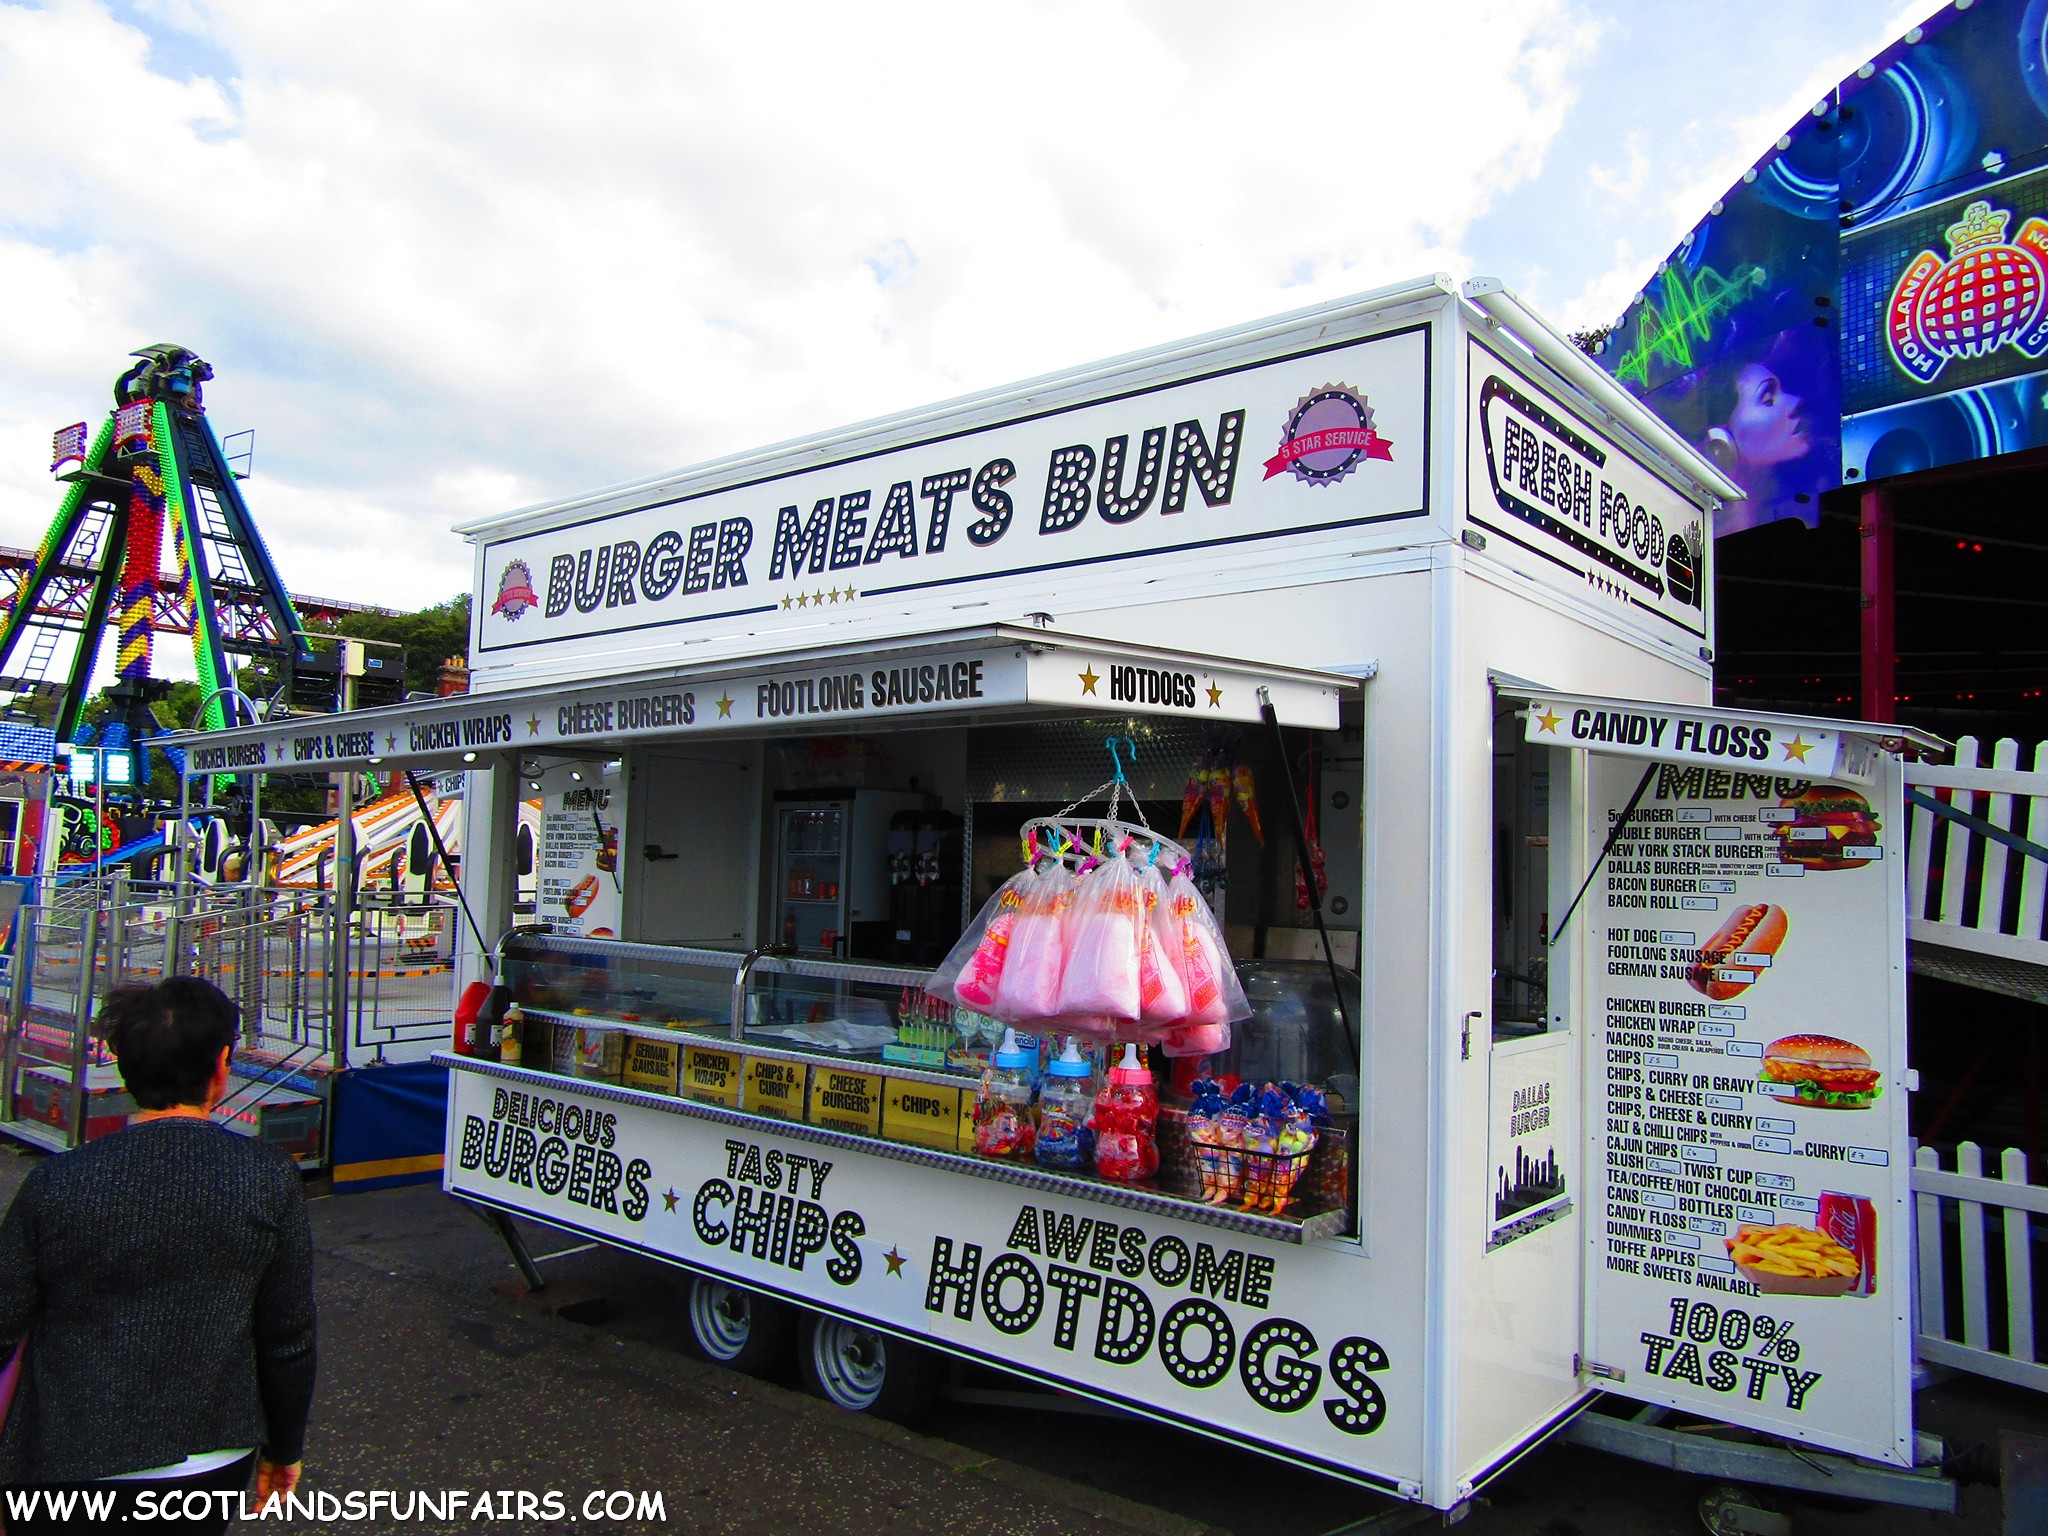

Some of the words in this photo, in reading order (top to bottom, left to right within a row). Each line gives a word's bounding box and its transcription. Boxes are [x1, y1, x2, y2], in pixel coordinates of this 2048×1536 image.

[2027, 230, 2048, 256] NO
[1896, 262, 1934, 372] HOLLAND
[1282, 445, 1290, 459] 5
[1293, 435, 1322, 455] STAR
[1325, 431, 1373, 447] SERVICE
[1503, 416, 1592, 529] FRESH
[1600, 479, 1665, 568] FOOD
[545, 515, 754, 619] BURGER
[769, 458, 1017, 580] MEATS
[1040, 408, 1247, 536] BUN
[757, 674, 864, 718] FOOTLONG
[871, 660, 983, 707] SAUSAGE
[1109, 665, 1196, 709] HOTDOGS
[557, 702, 613, 736] CHEESE
[617, 692, 696, 730] BURGERS
[409, 722, 460, 751] CHICKEN
[463, 713, 512, 745] WRAPS
[1571, 709, 1669, 748] CANDY
[1675, 721, 1772, 761] FLOSS
[194, 749, 227, 770] CHICKEN
[228, 743, 267, 767] BURGERS
[294, 736, 323, 761] CHIPS
[325, 737, 335, 758] &
[336, 731, 375, 758] CHEESE
[445, 773, 466, 793] CHIPS
[1656, 764, 1812, 799] MENU
[1630, 809, 1674, 822] BURGER
[1733, 815, 1757, 823] CHEESE
[1655, 827, 1701, 840] BURGER
[1608, 844, 1634, 857] NEW
[1638, 844, 1668, 857] YORK
[1673, 844, 1711, 858] STACK
[1715, 845, 1763, 858] BURGER
[1608, 861, 1651, 874] DALLAS
[1655, 861, 1701, 875] BURGER
[1608, 877, 1647, 891] BACON
[1650, 879, 1697, 892] BURGER
[1608, 894, 1647, 908] BACON
[1650, 896, 1679, 909] ROLL
[1608, 928, 1630, 942] HOT
[1634, 929, 1657, 943] DOG
[1608, 945, 1667, 961] FOOTLONG
[1670, 948, 1727, 965] SAUSAGE
[1608, 962, 1657, 978] GERMAN
[1660, 965, 1716, 982] SAUSAE
[1606, 998, 1655, 1014] CHICKEN
[1659, 1001, 1706, 1017] BURGER
[1606, 1015, 1655, 1031] CHICKEN
[1659, 1018, 1695, 1034] WRAP
[635, 1040, 669, 1062] GERMAN
[1606, 1031, 1654, 1048] NACHOS
[631, 1057, 670, 1077] SAUSAGE
[692, 1052, 730, 1072] CHICKEN
[1607, 1049, 1641, 1065] CHIPS
[694, 1068, 726, 1088] WRAPS
[754, 1062, 784, 1081] CHIPS
[785, 1066, 795, 1081] &
[1607, 1066, 1644, 1084] CHIPS,
[1649, 1070, 1688, 1086] CURRY
[1692, 1075, 1709, 1089] OR
[1713, 1076, 1754, 1093] GRAVY
[758, 1079, 790, 1099] CURRY
[829, 1074, 867, 1095] CHEESE
[1607, 1083, 1641, 1099] CHIPS
[1645, 1087, 1655, 1101] &
[1659, 1089, 1702, 1106] CHEESE
[821, 1090, 870, 1114] BURGERS
[901, 1095, 940, 1117] CHIPS
[1512, 1082, 1550, 1113] DALLAS
[492, 1087, 617, 1149] DELICIOUS
[1510, 1106, 1550, 1138] BURGER
[1607, 1101, 1645, 1119] CHIPS,
[1649, 1105, 1692, 1123] CHEESE
[1696, 1110, 1707, 1125] &
[1711, 1112, 1753, 1130] CURRY
[1607, 1118, 1629, 1133] SALT
[1633, 1121, 1641, 1135] &
[1644, 1123, 1673, 1139] CHILLI
[1677, 1126, 1707, 1144] CHIPS
[1607, 1136, 1642, 1153] CAJUN
[1646, 1141, 1677, 1158] CHIPS
[1805, 1142, 1846, 1160] CURRY
[459, 1115, 652, 1222] BURGERS
[724, 1139, 833, 1200] TASTY
[1607, 1152, 1643, 1169] SLUSH
[1683, 1163, 1722, 1180] TWIST
[1727, 1168, 1752, 1184] CUP
[1607, 1168, 1700, 1195] TEA/COFFEE/HOT
[1705, 1183, 1777, 1207] CHOCOLATE
[1607, 1186, 1639, 1203] CANS
[1607, 1203, 1645, 1222] CANDY
[1650, 1210, 1686, 1229] FLOSS
[1679, 1197, 1733, 1219] BOTTLES
[692, 1178, 866, 1286] CHIPS
[1607, 1221, 1662, 1243] DUMMIES
[1006, 1205, 1275, 1310] AWESOME
[1607, 1238, 1646, 1258] TOFFEE
[1650, 1246, 1695, 1267] APPLES
[1607, 1256, 1639, 1274] MORE
[1643, 1263, 1692, 1285] SWEETS
[1696, 1273, 1761, 1297] AVAILABLE
[925, 1235, 1390, 1436] HOTDOGS
[1669, 1298, 1800, 1363] 100%
[1640, 1332, 1822, 1411] TASTY
